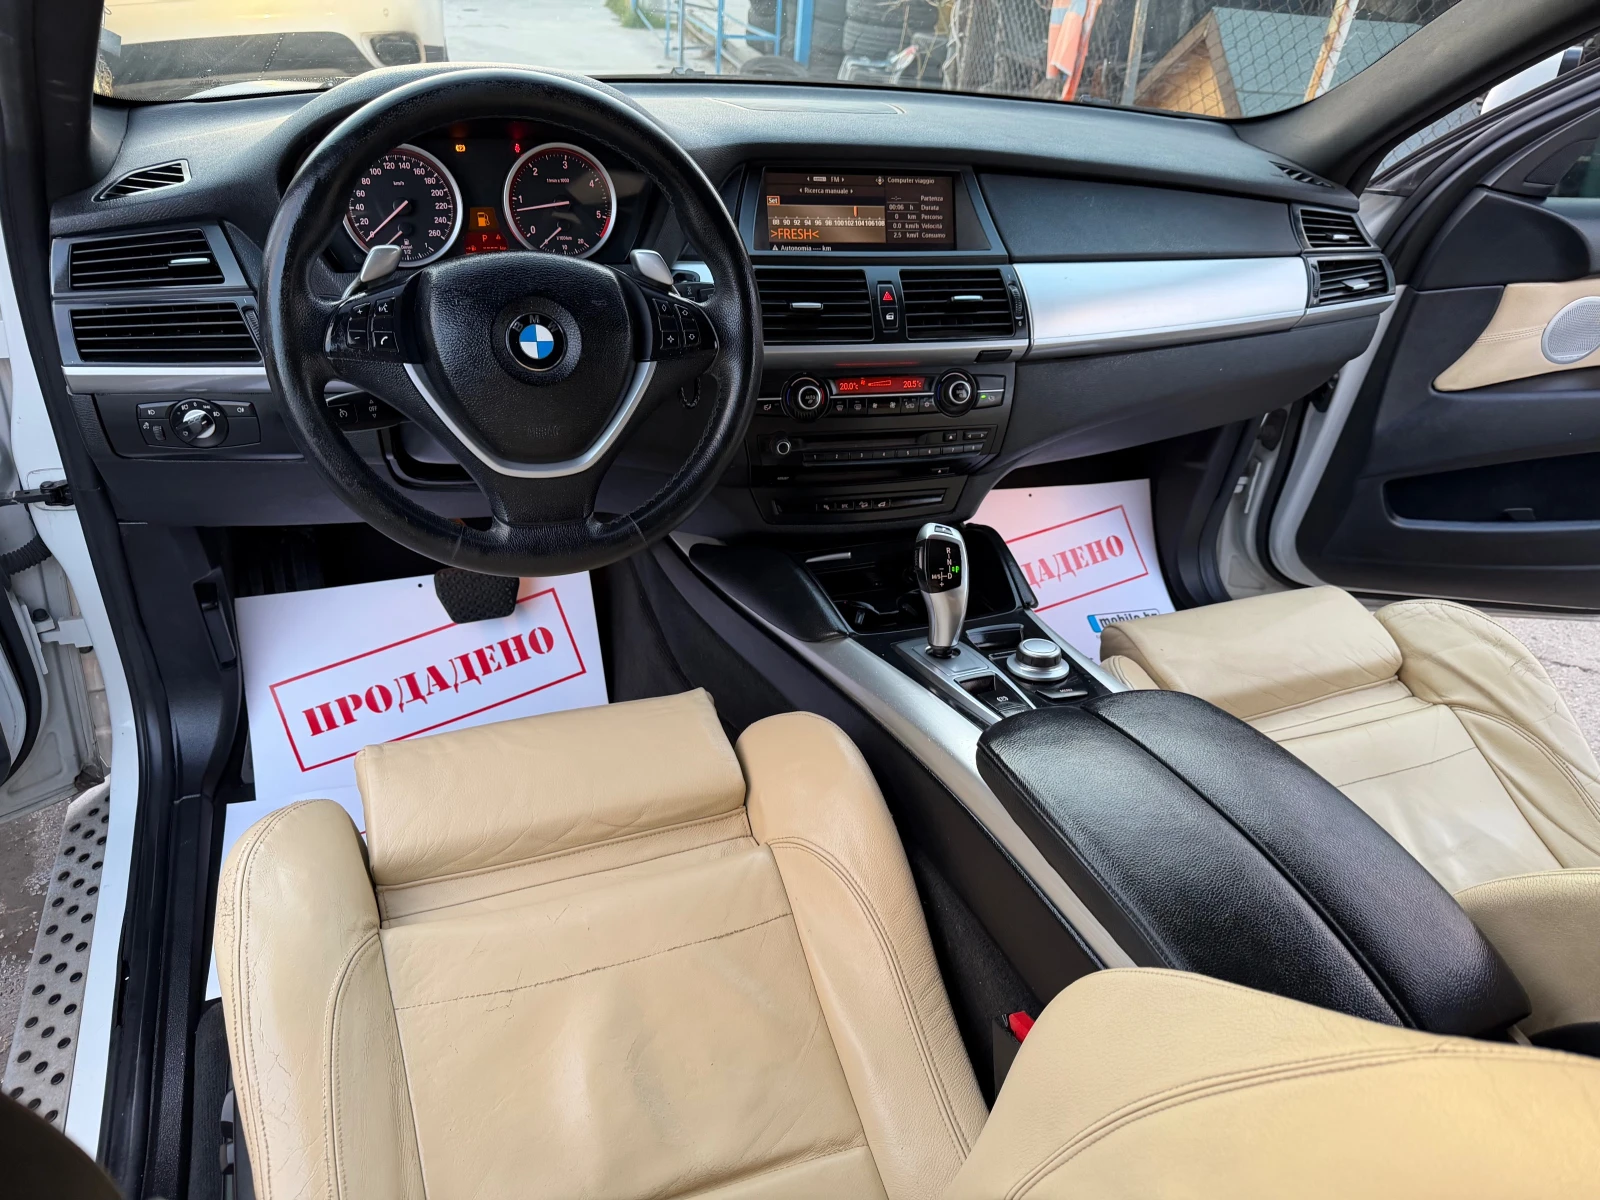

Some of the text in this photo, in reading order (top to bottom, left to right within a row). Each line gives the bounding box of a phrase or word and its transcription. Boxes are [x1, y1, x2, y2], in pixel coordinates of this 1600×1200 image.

[383, 162, 395, 170] 120
[398, 162, 411, 170] 140
[562, 161, 568, 169] 3
[532, 168, 539, 176] 2
[361, 177, 371, 185] 80
[424, 177, 436, 185] 180
[589, 180, 595, 188] 4
[887, 177, 935, 185] Computer viaggio
[430, 189, 444, 197] 200
[804, 187, 849, 195] Ricerca manuale
[518, 195, 523, 203] 1
[355, 203, 365, 211] 40
[596, 211, 602, 219] 5
[434, 216, 447, 224] 240
[530, 226, 536, 234] 0
[905, 222, 920, 230] km/h
[921, 222, 943, 230] Velocità
[428, 229, 441, 237] 260
[771, 228, 820, 240] >FRESH<
[482, 234, 488, 242] P
[512, 314, 559, 333] BMW
[1021, 535, 1125, 589] ДАДЕНО
[301, 626, 556, 737] ПРОДАДЕНО
